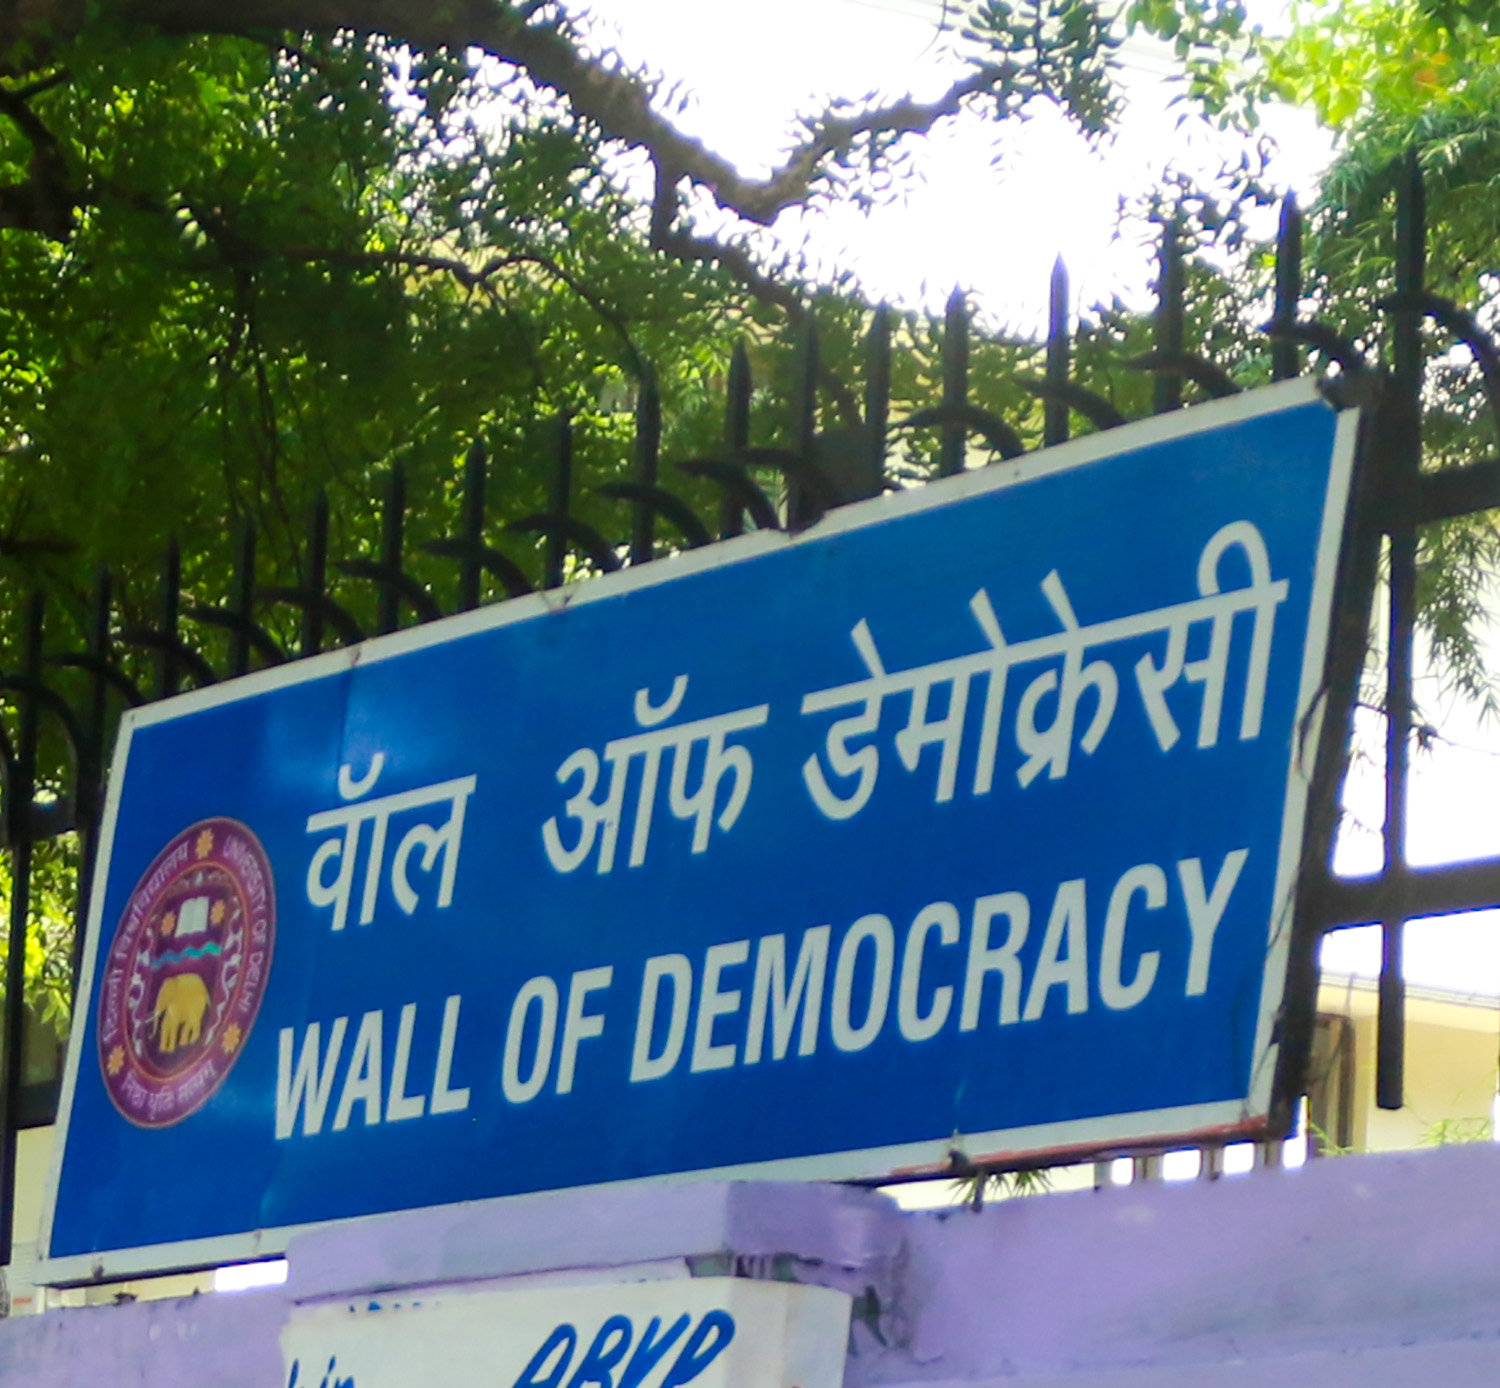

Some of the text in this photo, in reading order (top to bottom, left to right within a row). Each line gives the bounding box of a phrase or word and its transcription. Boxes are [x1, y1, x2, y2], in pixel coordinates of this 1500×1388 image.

[306, 519, 1288, 931] वॉल ऑफ डेमोक्रेसी
[273, 992, 470, 1140] WALL
[501, 966, 608, 1104] OF
[631, 848, 1249, 1083] DEMOCRACY
